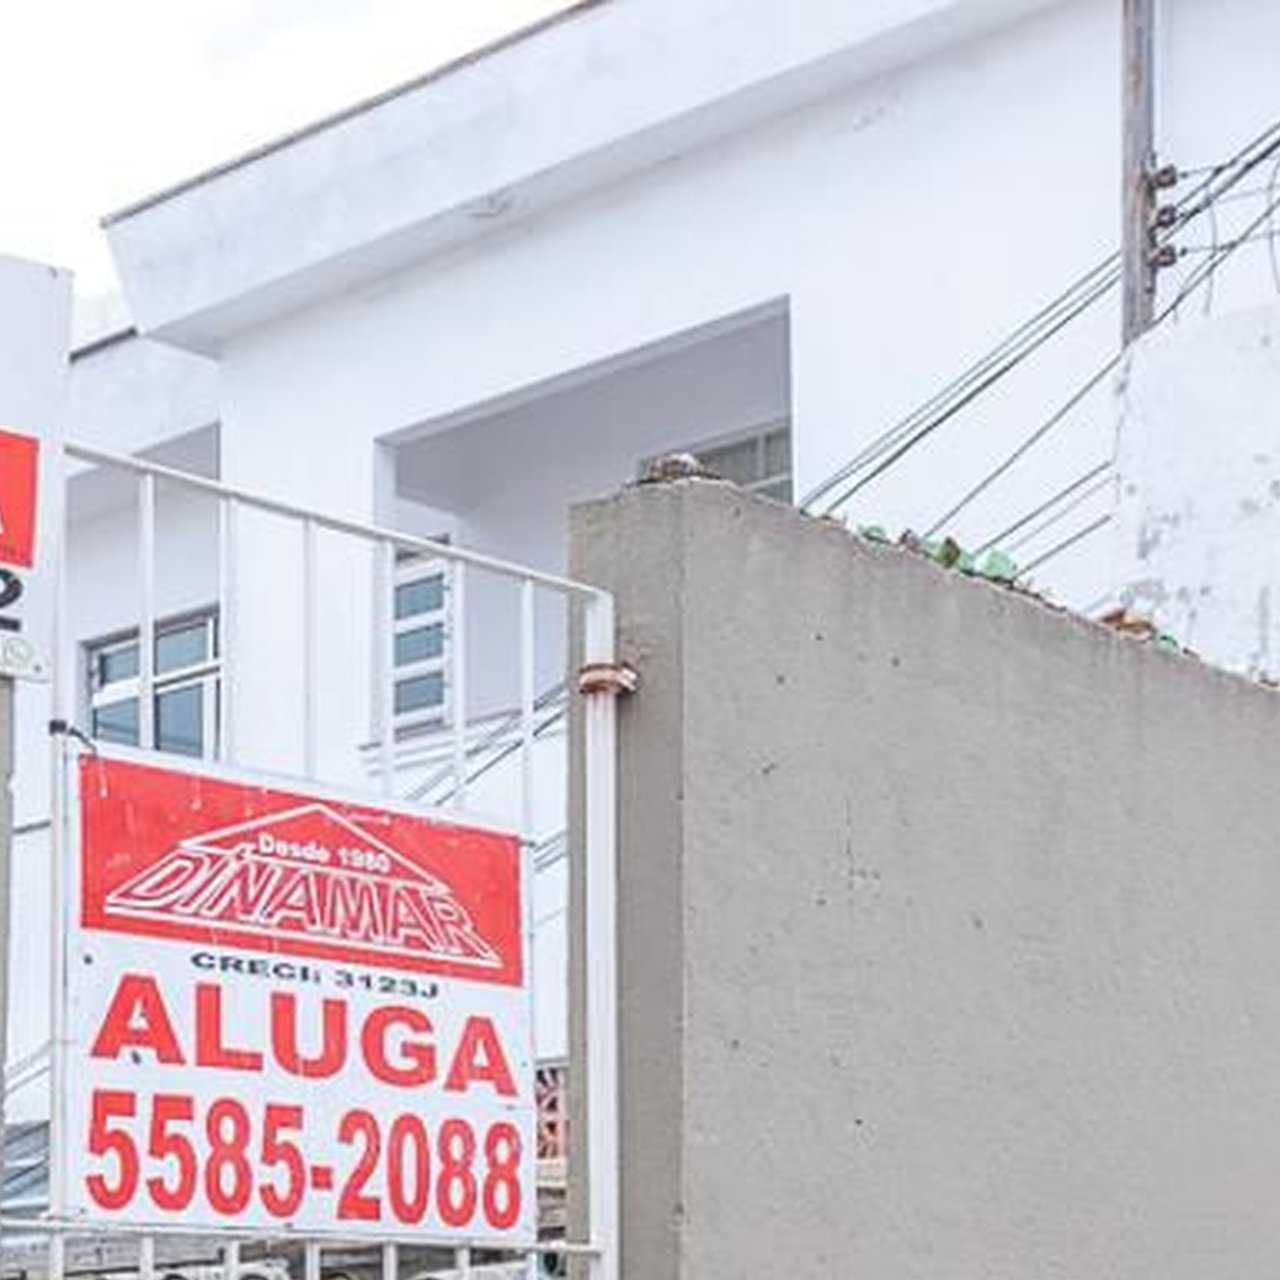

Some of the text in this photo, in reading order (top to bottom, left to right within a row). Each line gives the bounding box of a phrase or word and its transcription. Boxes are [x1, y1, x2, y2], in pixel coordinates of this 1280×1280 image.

[107, 845, 500, 962] DINAMAR
[258, 831, 332, 864] Desde
[90, 973, 520, 1098] ALUGA
[85, 1088, 523, 1231] 5585-2088
